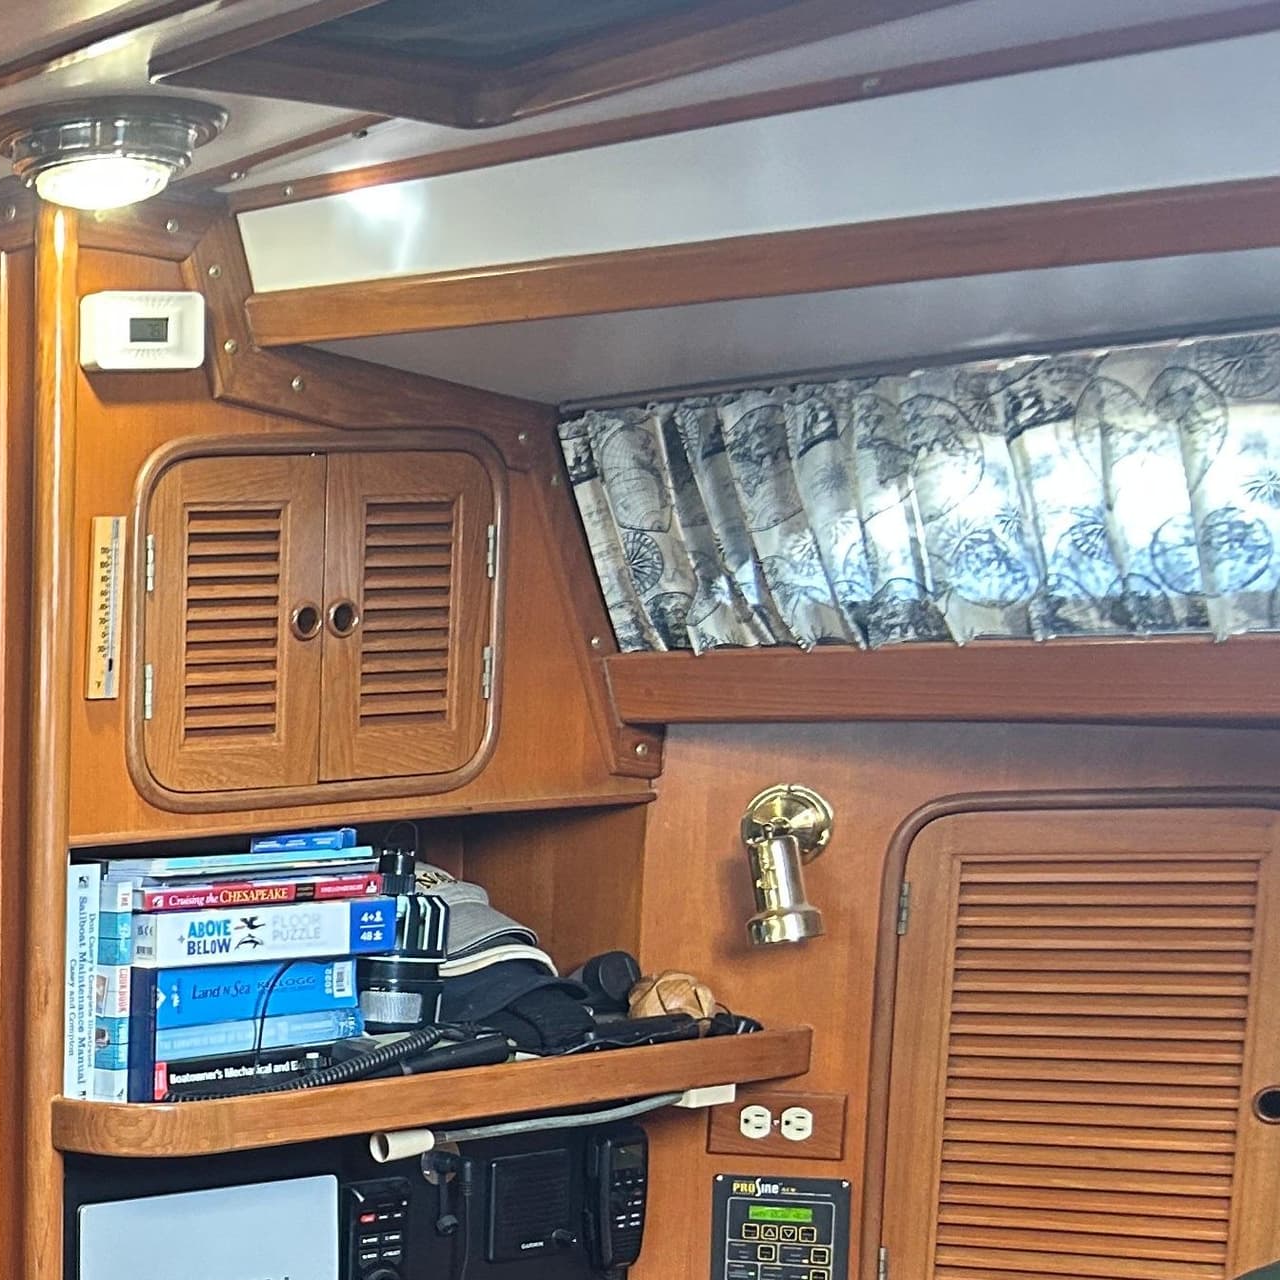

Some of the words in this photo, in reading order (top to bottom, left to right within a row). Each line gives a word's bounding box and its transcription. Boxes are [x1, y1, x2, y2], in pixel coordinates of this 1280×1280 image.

[169, 895, 204, 907] Cruising
[206, 892, 219, 904] the
[220, 887, 289, 904] CHESAPEAKE
[78, 896, 88, 948] Sailboat
[187, 919, 232, 938] ABOVE
[272, 912, 321, 929] FLOOR
[271, 926, 321, 942] PUZZLE
[187, 938, 232, 955] BELOW
[67, 959, 76, 987] Casey
[77, 952, 87, 1033] Maintenance
[192, 983, 221, 1000] Land
[223, 986, 230, 995] N
[232, 981, 251, 997] Sea
[76, 1037, 86, 1085] Manual
[273, 1060, 290, 1072] and
